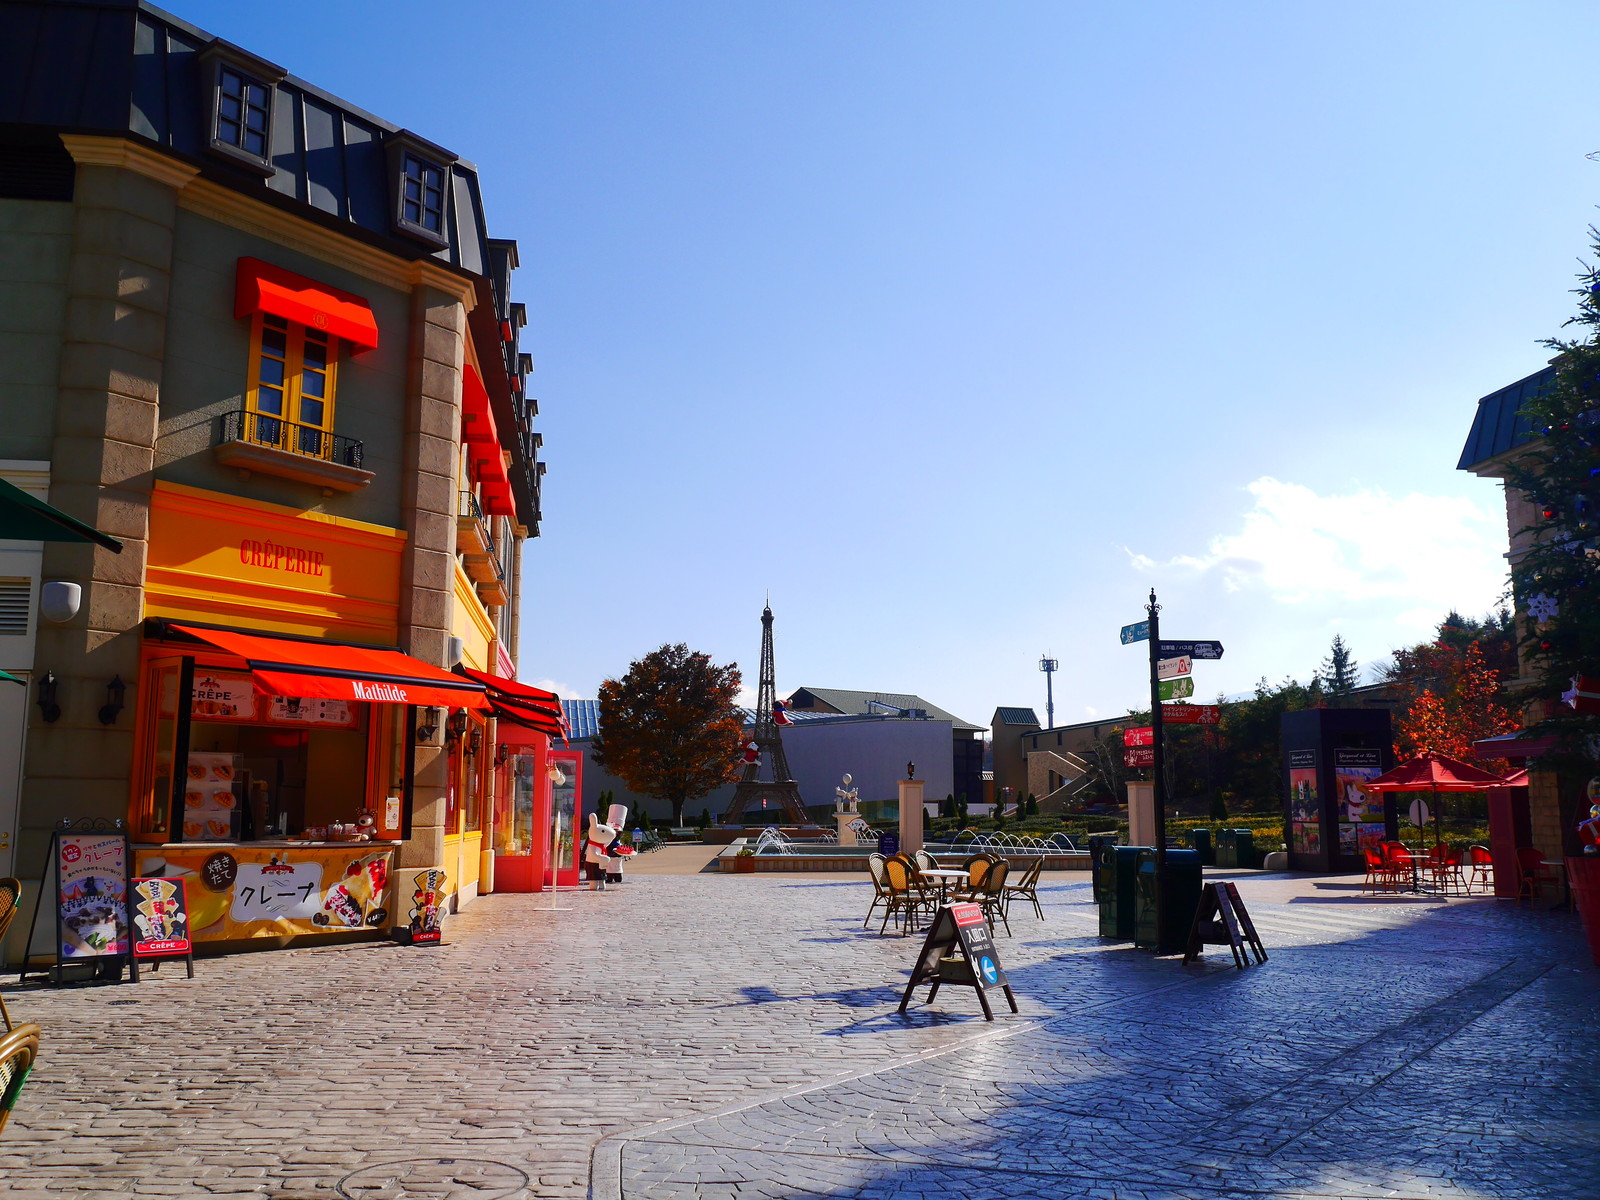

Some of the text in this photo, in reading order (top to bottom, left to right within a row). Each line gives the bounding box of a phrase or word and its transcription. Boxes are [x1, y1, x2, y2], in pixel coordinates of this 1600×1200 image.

[240, 539, 324, 576] CRÊPERIE
[352, 681, 408, 702] Mathilde
[84, 846, 124, 864] クレープ
[207, 856, 230, 874] 焼き
[211, 870, 232, 885] たて
[240, 881, 314, 907] クレープ
[149, 941, 176, 950] CRÊPE
